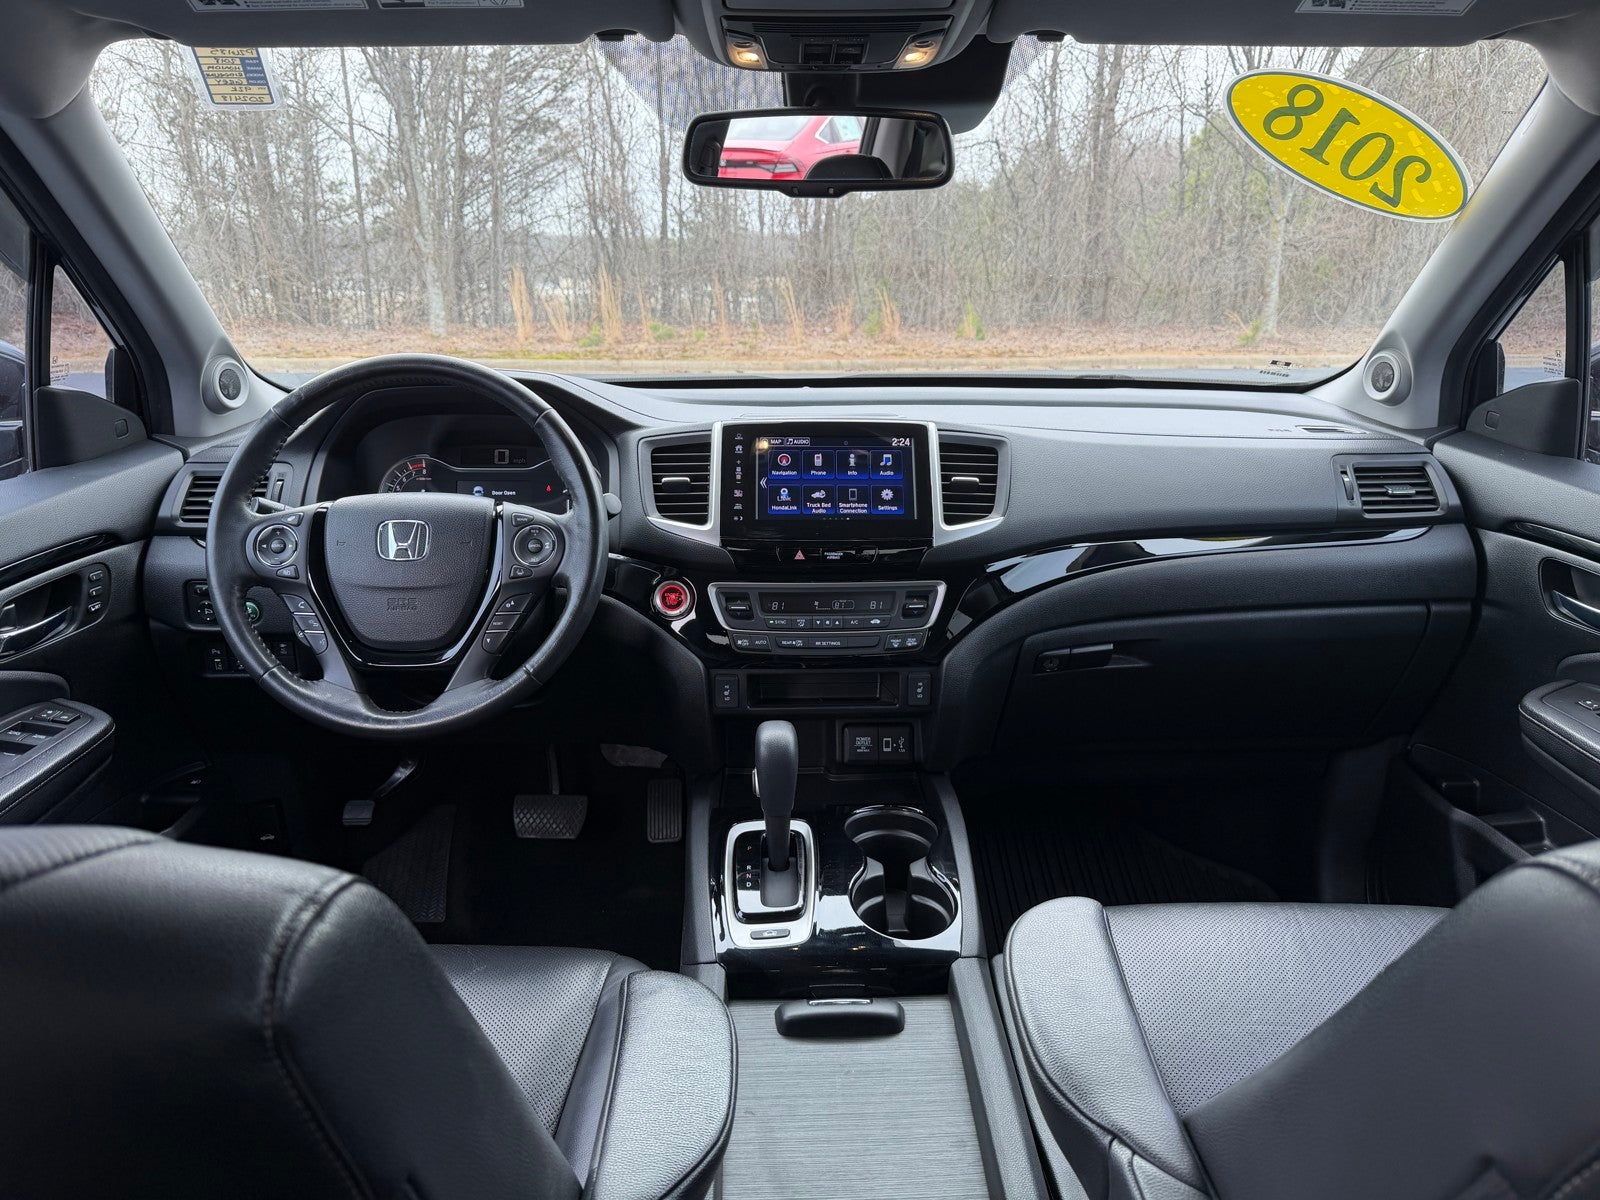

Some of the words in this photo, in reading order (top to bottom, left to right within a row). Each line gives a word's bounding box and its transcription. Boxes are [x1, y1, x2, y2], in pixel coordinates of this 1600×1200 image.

[891, 437, 911, 446] 2:24
[771, 601, 785, 610] 81
[870, 601, 883, 610] 81
